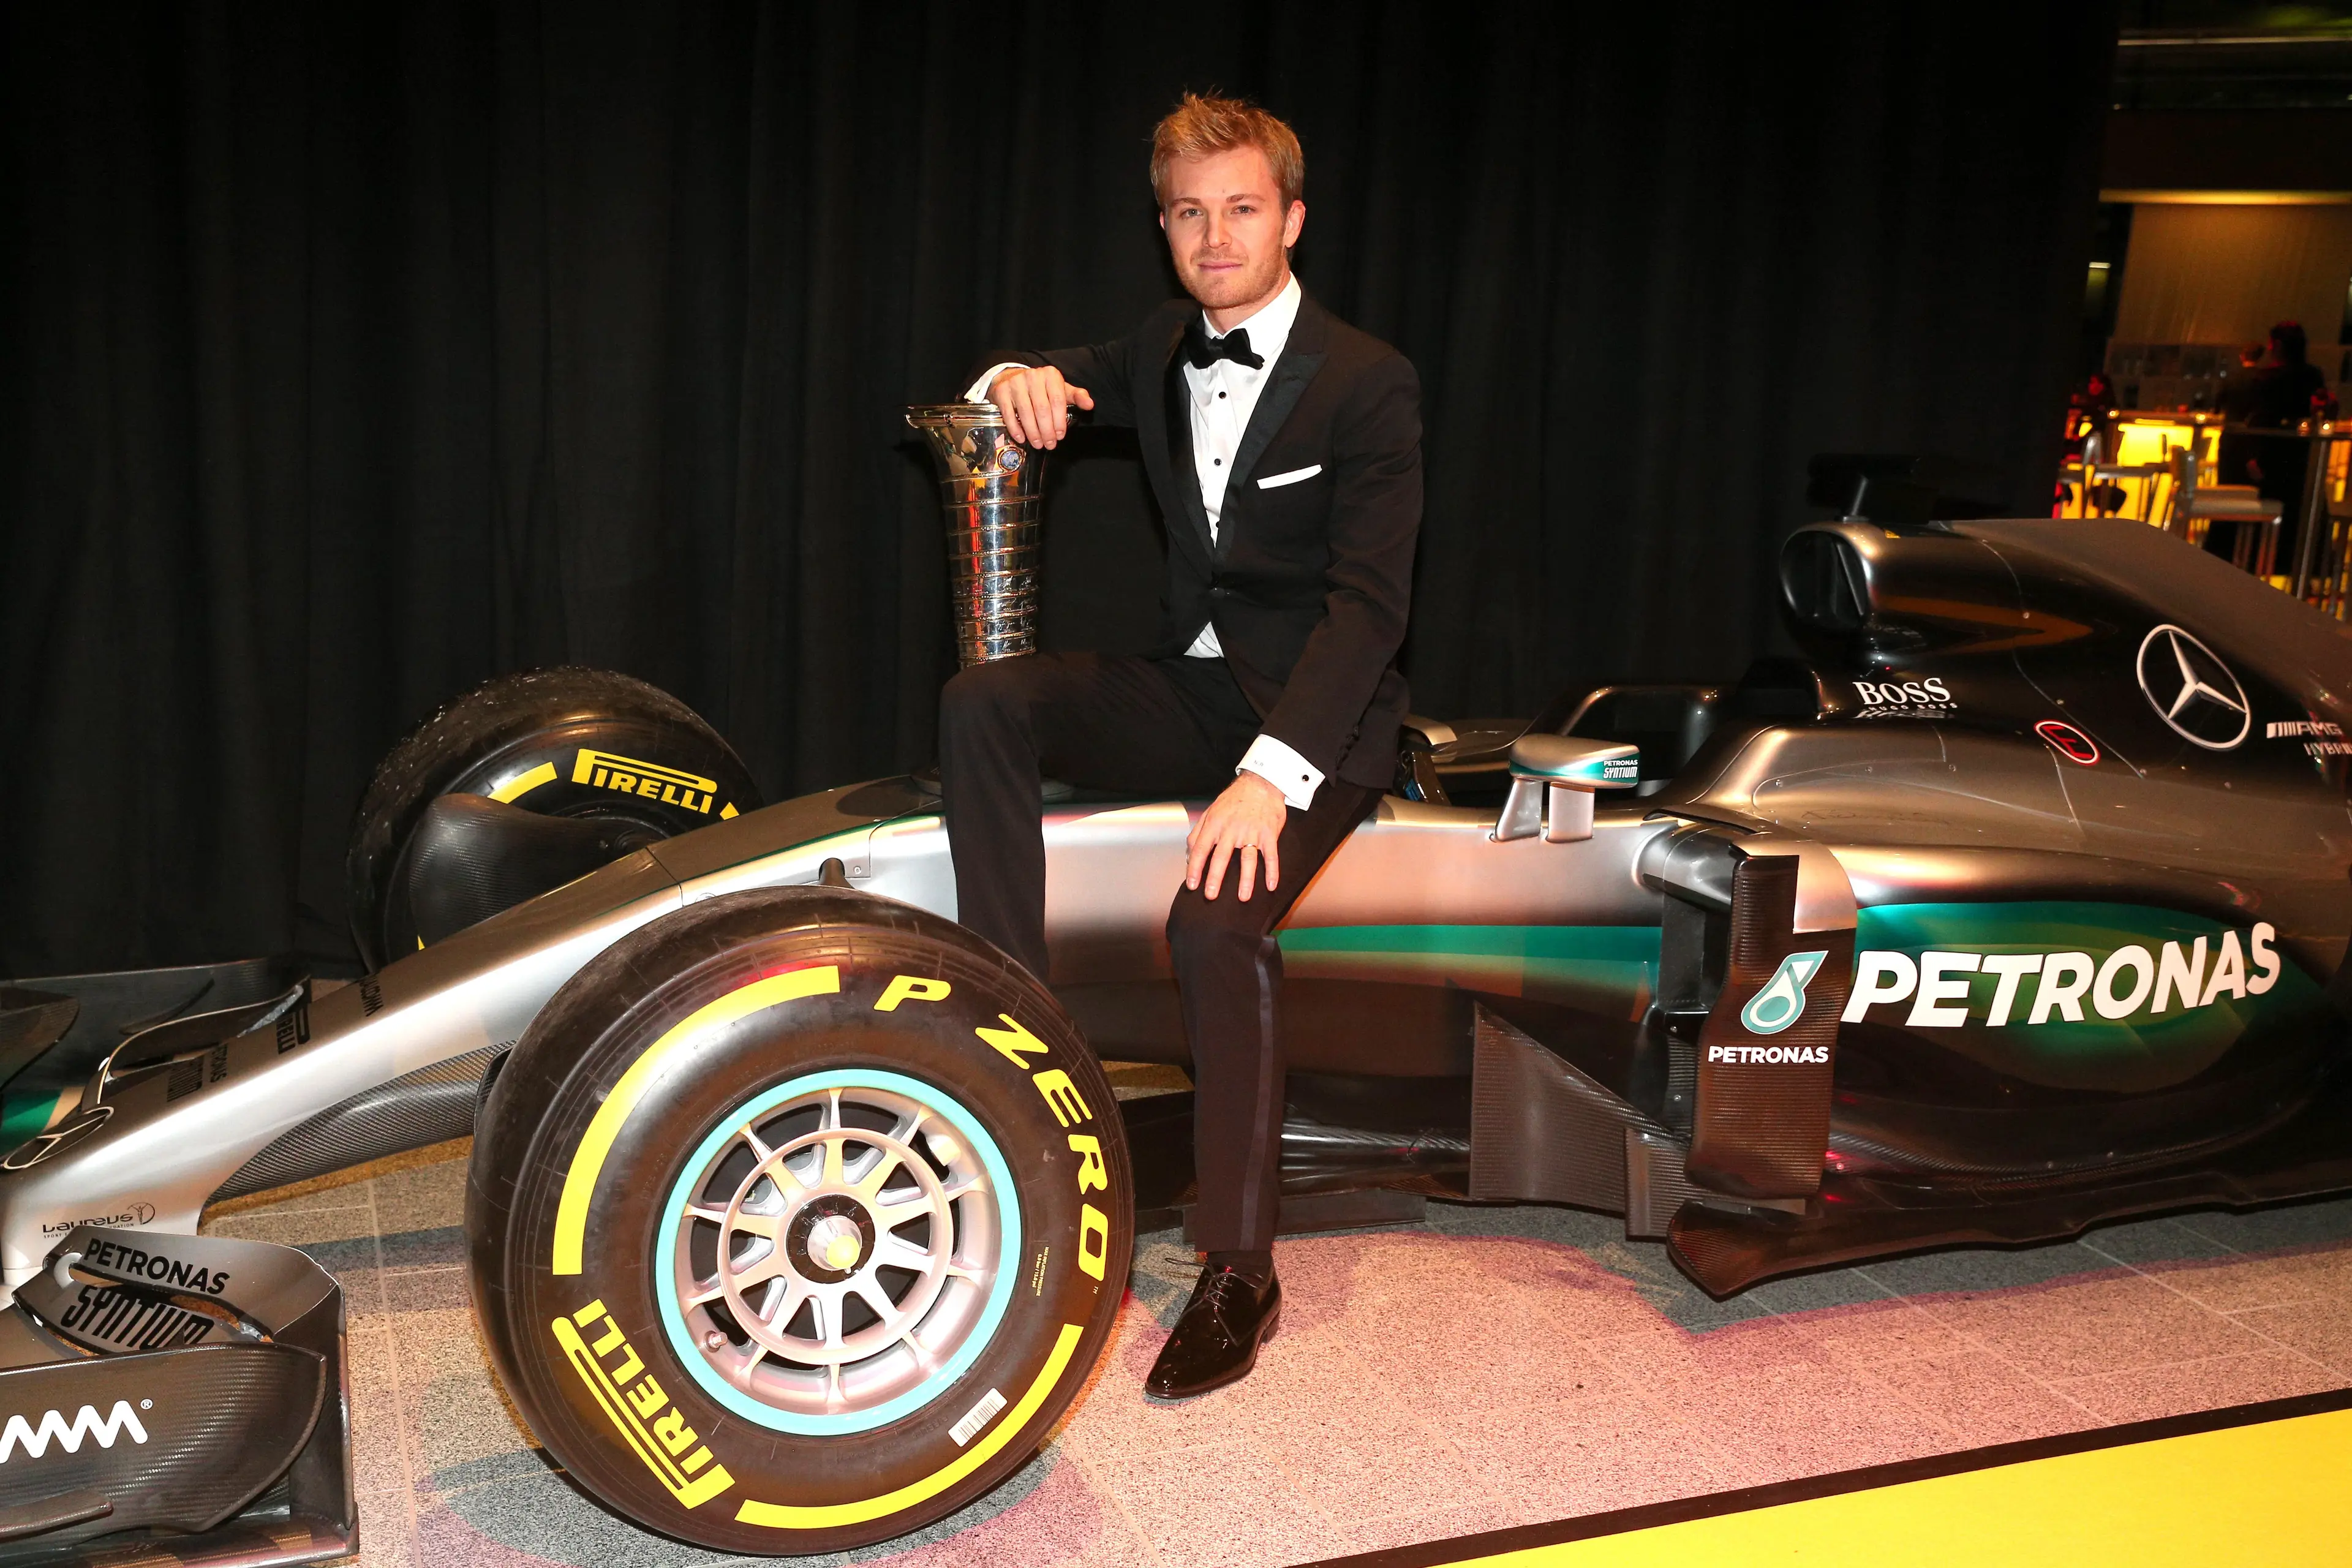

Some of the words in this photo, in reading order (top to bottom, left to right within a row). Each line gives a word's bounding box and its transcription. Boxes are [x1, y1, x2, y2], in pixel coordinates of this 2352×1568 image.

[1852, 677, 1951, 705] BOSS
[2296, 720, 2343, 736] AMG
[571, 748, 717, 814] PIRELLI
[1603, 766, 1638, 778] SYNTIUM
[1840, 922, 2282, 1027] PETRONAS
[1708, 1046, 1830, 1064] PETRONAS
[873, 974, 951, 1012] P
[975, 1013, 1109, 1281] ZERO
[83, 1238, 230, 1295] PETRONAS
[1035, 1276, 1044, 1297] PRESSURE
[60, 1284, 215, 1349] SYNTIUM
[551, 1298, 736, 1509] PIRELLI
